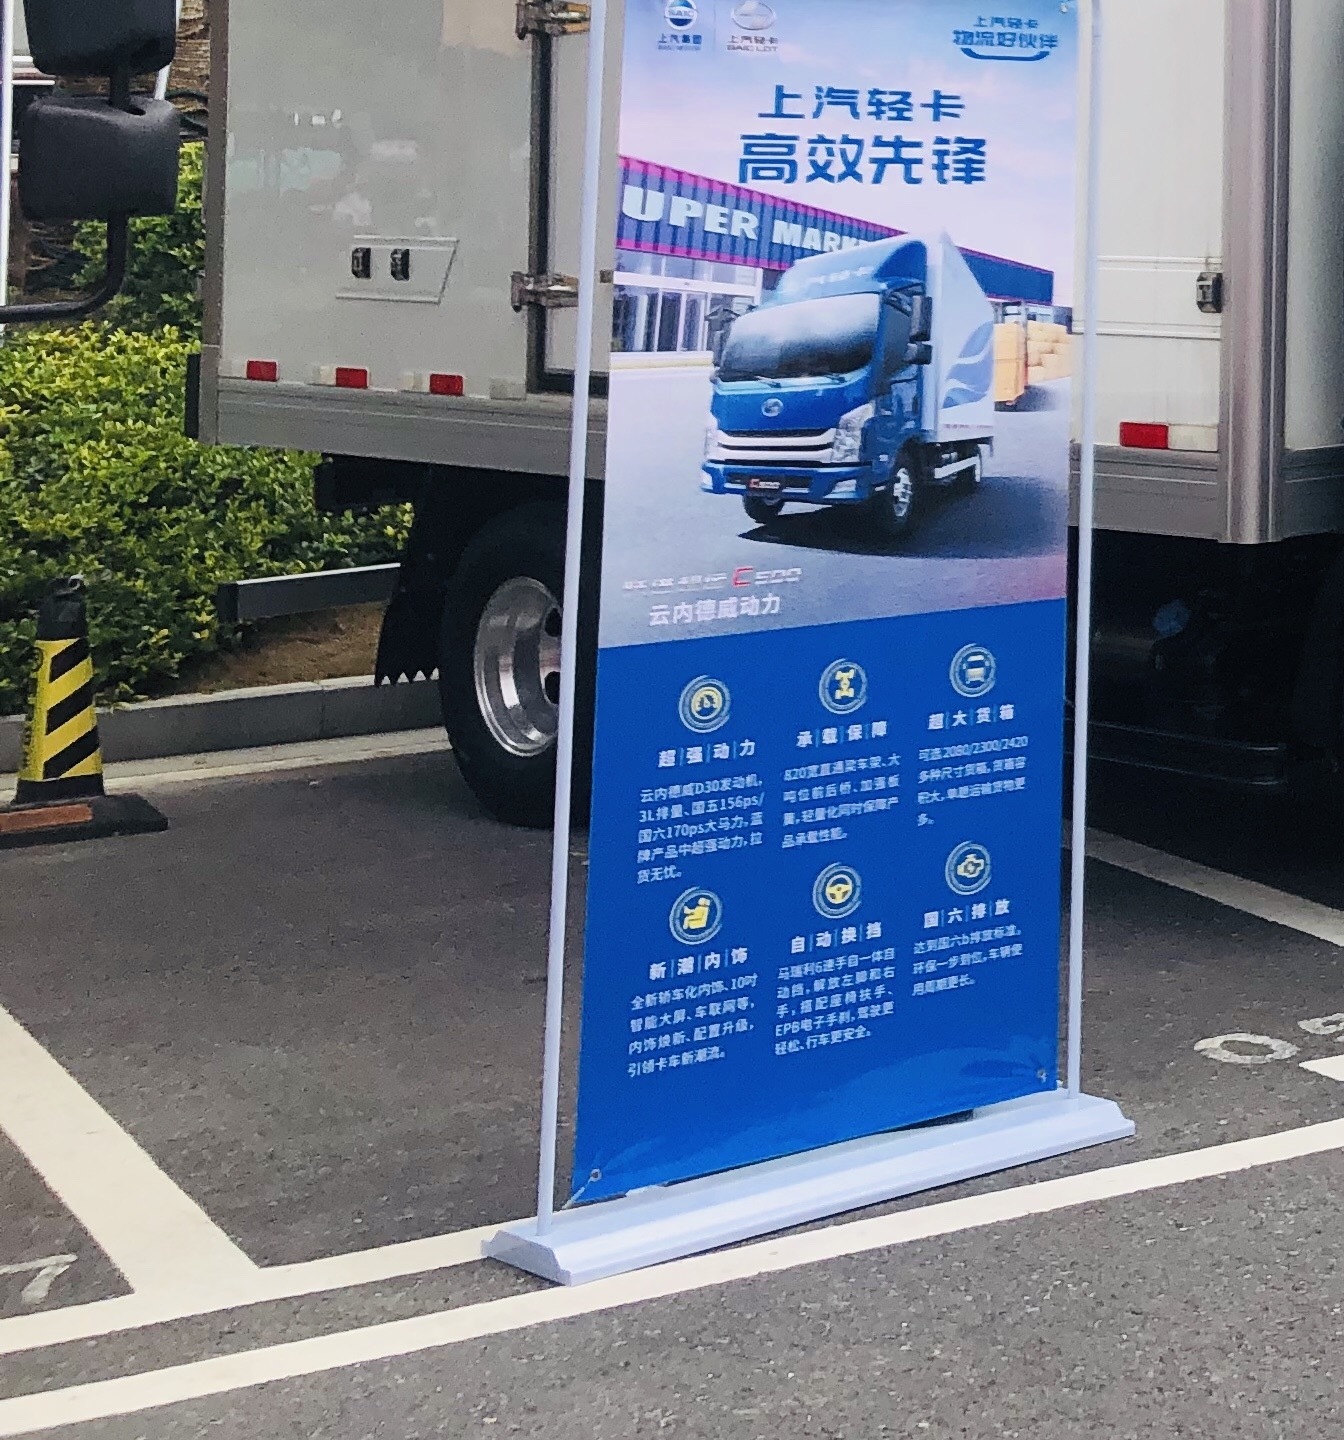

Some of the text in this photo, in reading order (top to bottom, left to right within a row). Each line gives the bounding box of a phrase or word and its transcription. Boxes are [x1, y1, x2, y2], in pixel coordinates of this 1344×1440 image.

[758, 84, 966, 122] 上汽轻卡
[738, 133, 987, 185] 高效先锋
[650, 593, 781, 626] 云内德威动力
[649, 947, 748, 980] 新潮内饰
